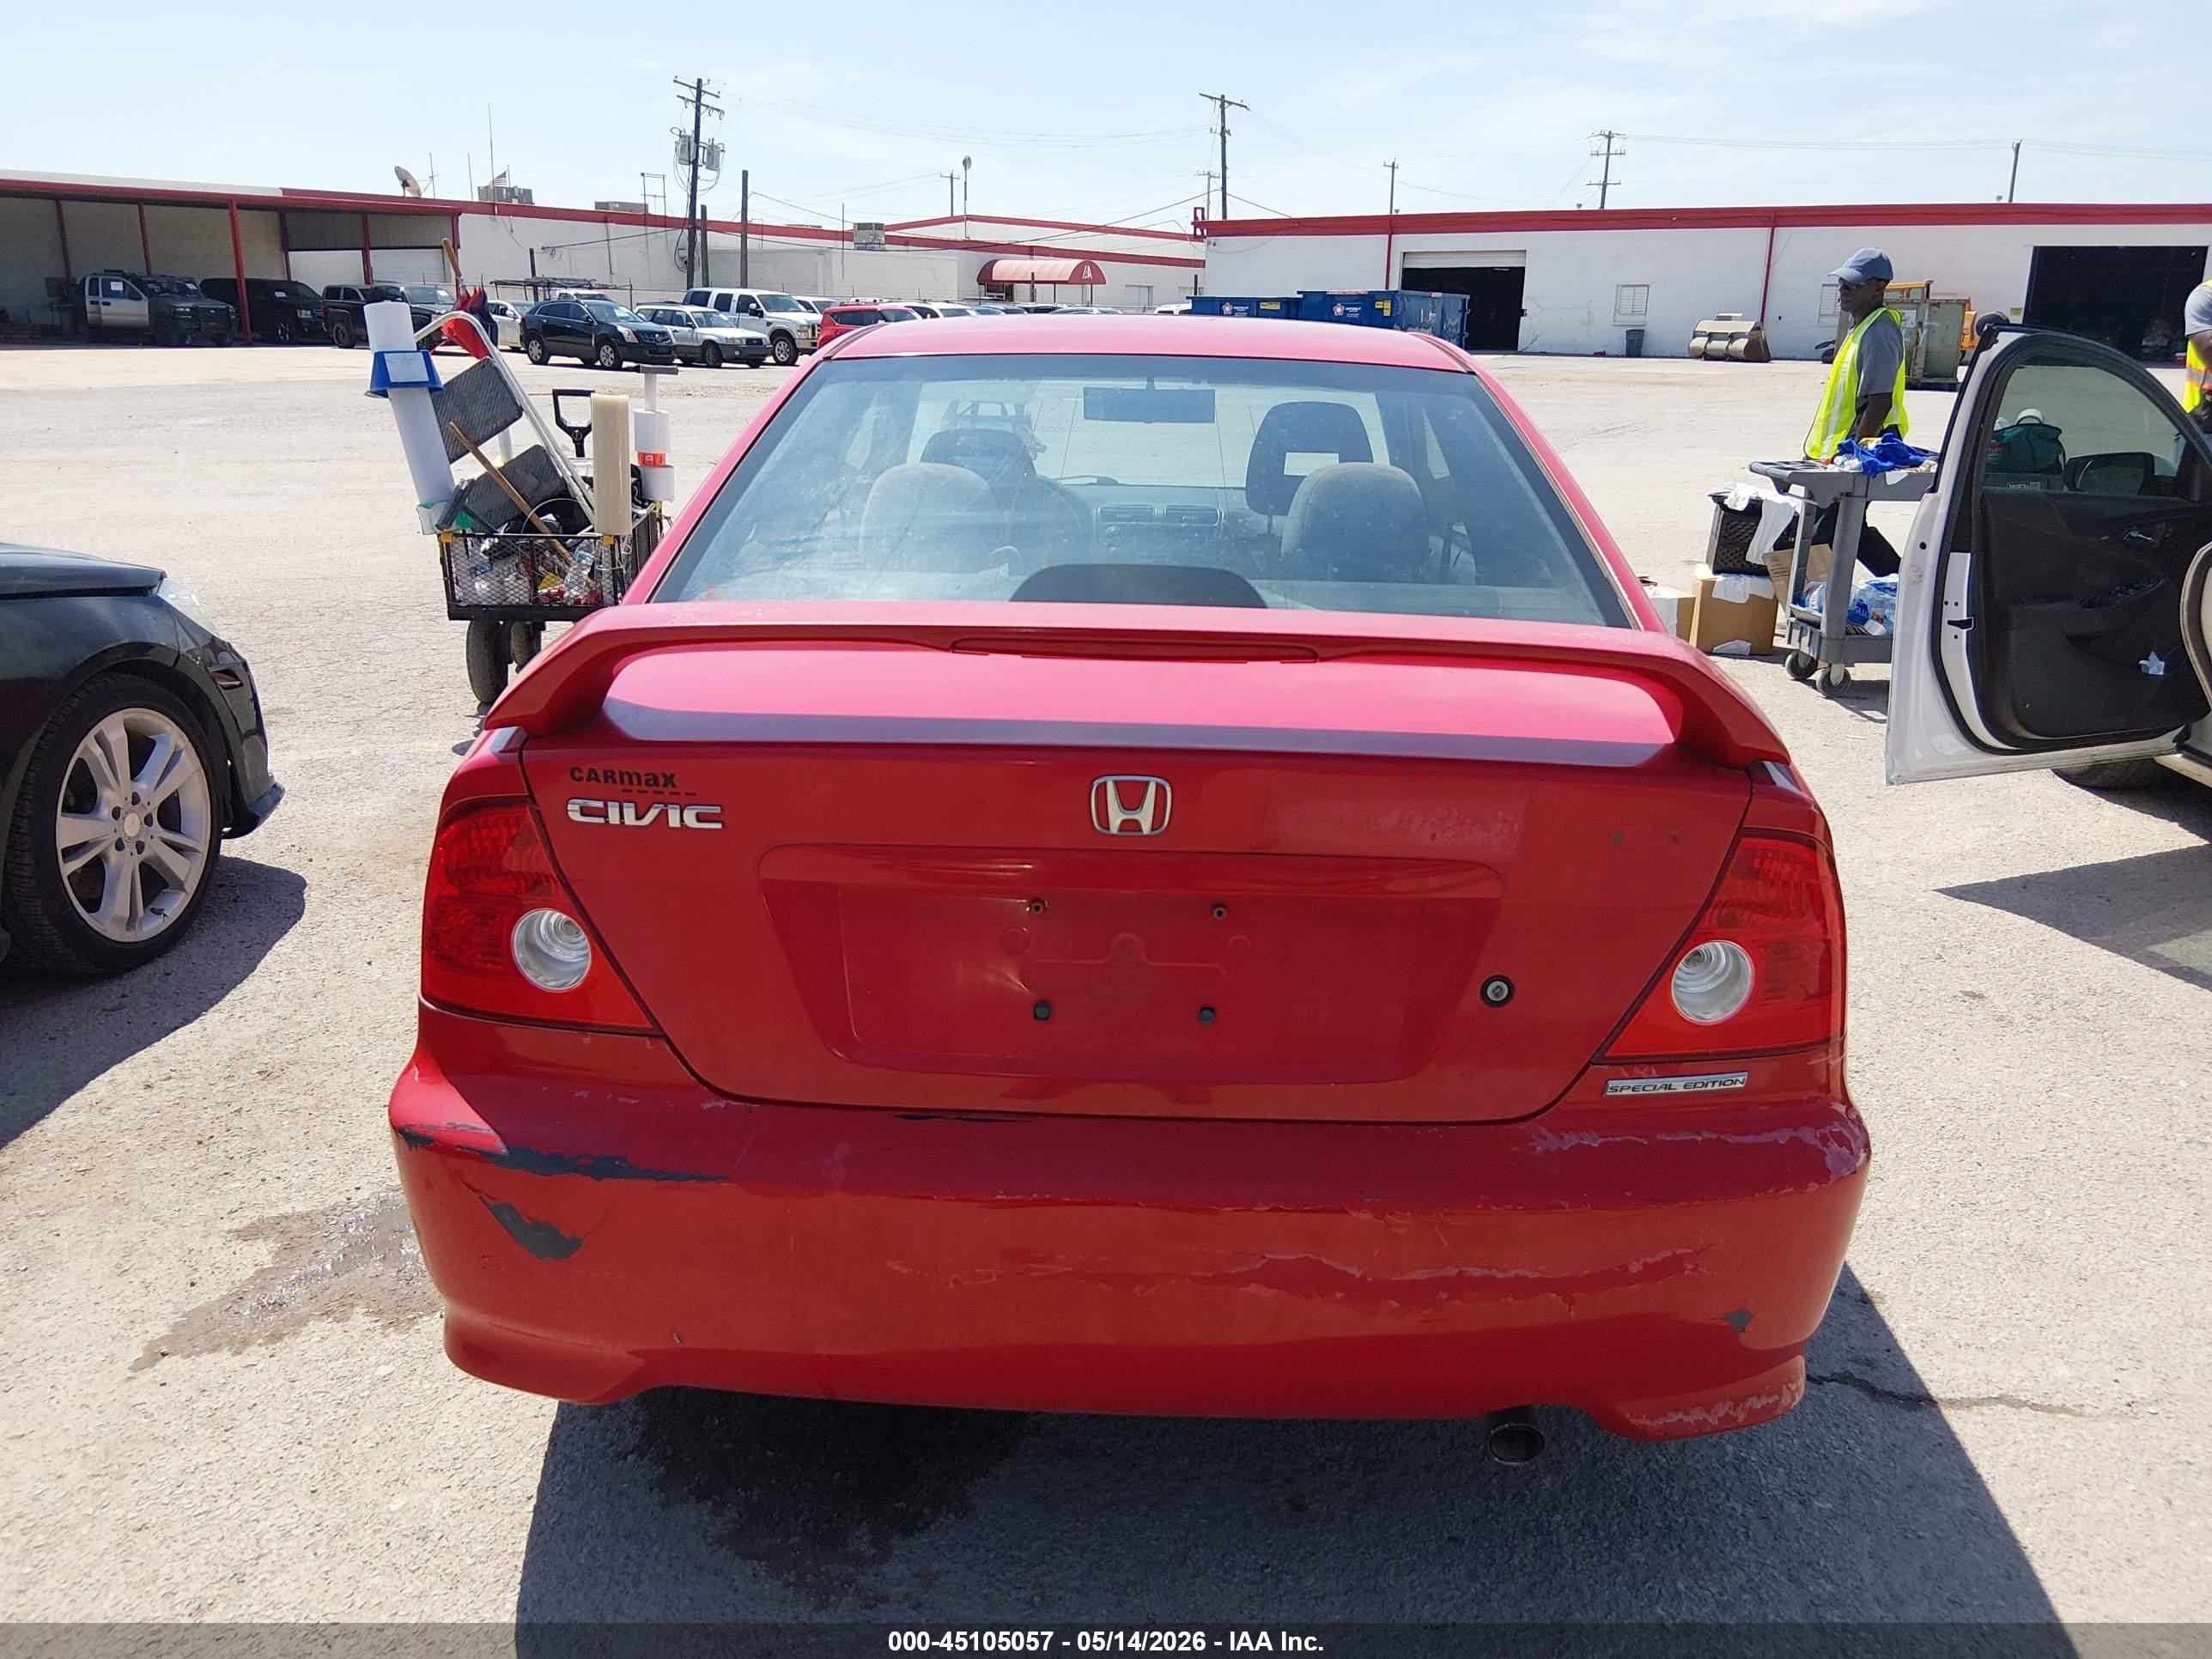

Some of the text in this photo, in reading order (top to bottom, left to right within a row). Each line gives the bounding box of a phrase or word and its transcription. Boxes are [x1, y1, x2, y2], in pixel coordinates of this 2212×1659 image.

[567, 799, 723, 830] CIVIC
[1607, 1077, 1746, 1094] SPECIAL EDITION
